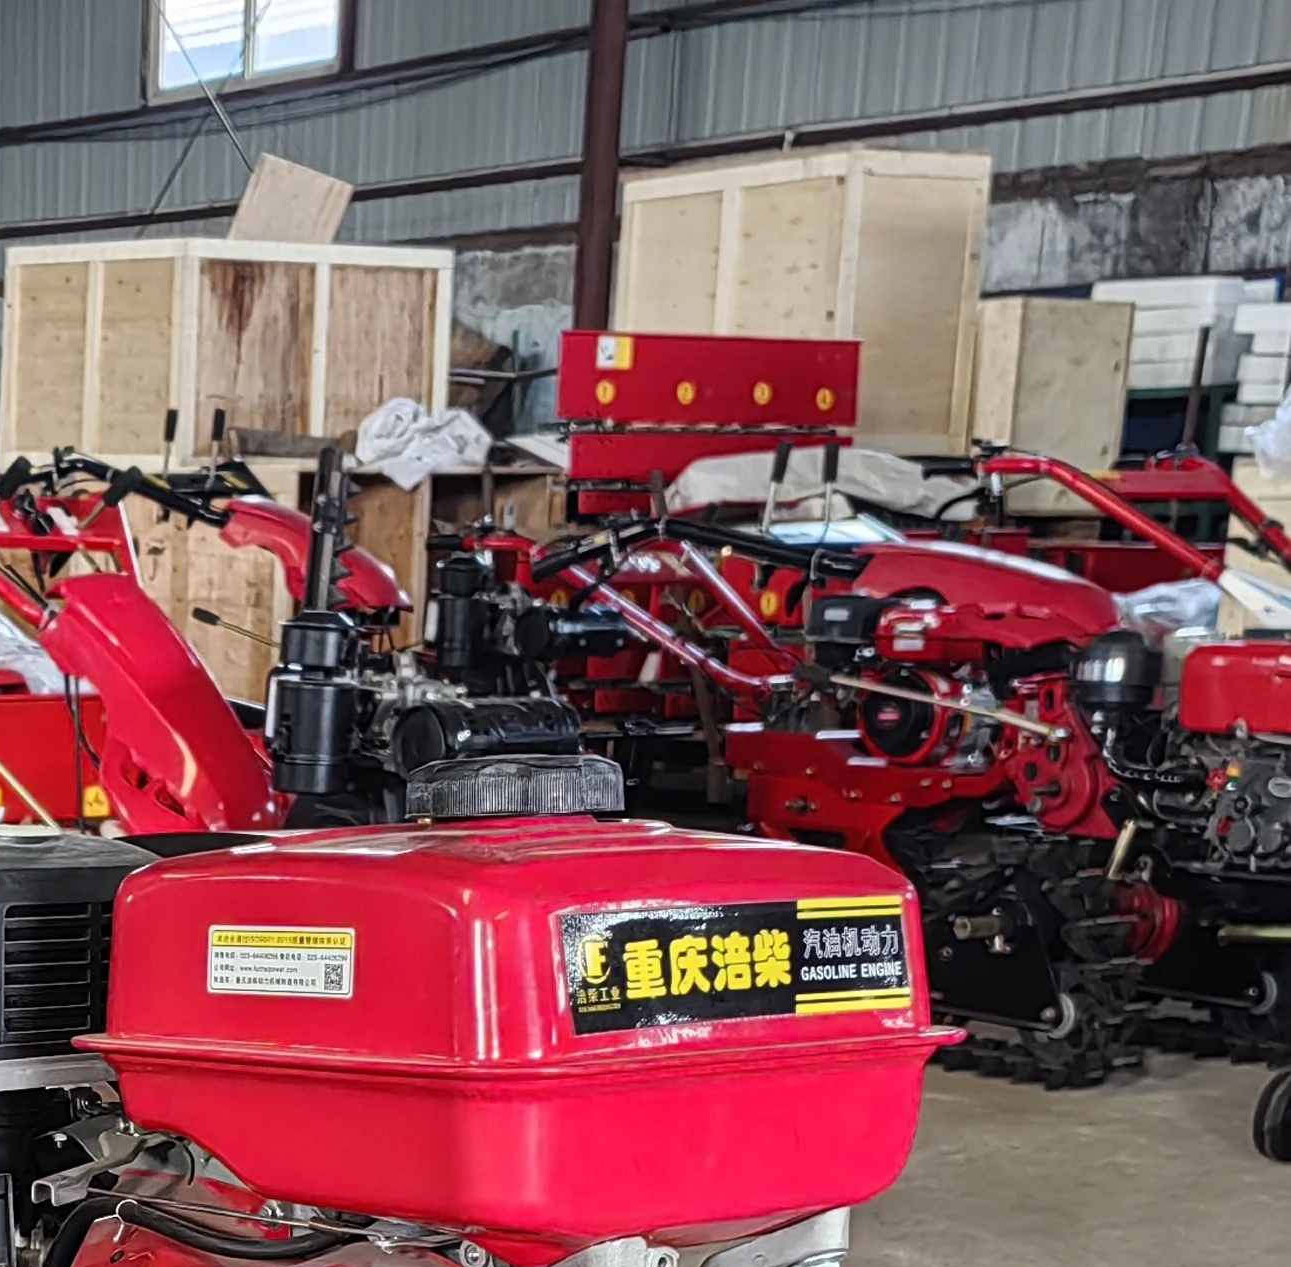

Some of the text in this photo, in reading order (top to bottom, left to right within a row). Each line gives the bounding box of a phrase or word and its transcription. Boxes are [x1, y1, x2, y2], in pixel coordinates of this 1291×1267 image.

[802, 924, 900, 960] 汽油机动力
[622, 927, 792, 1000] 重庆涪柴
[801, 960, 903, 983] GASOLINE ENGINE
